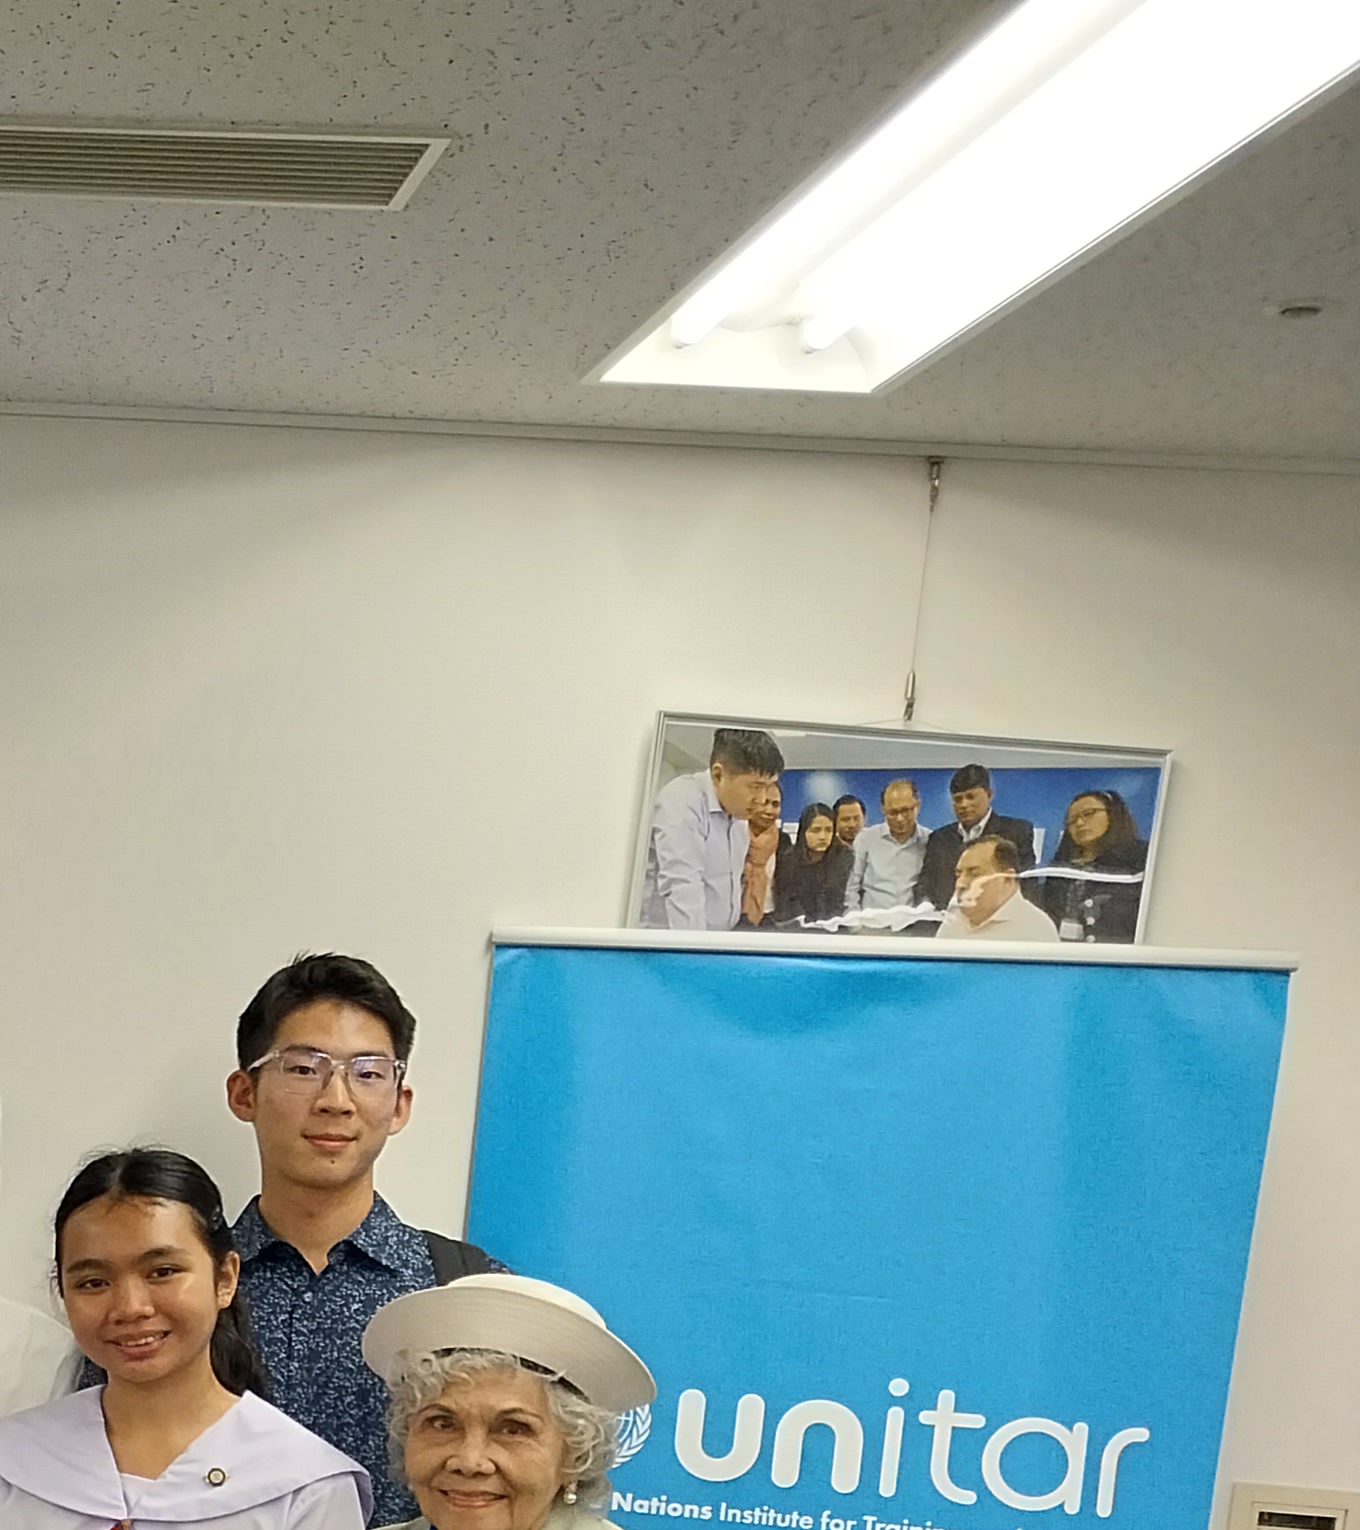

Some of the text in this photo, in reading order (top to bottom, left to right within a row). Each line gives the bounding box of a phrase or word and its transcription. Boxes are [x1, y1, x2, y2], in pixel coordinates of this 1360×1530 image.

[674, 1377, 1150, 1518] unitar
[611, 1491, 713, 1520] Nations
[719, 1502, 814, 1530] Institute
